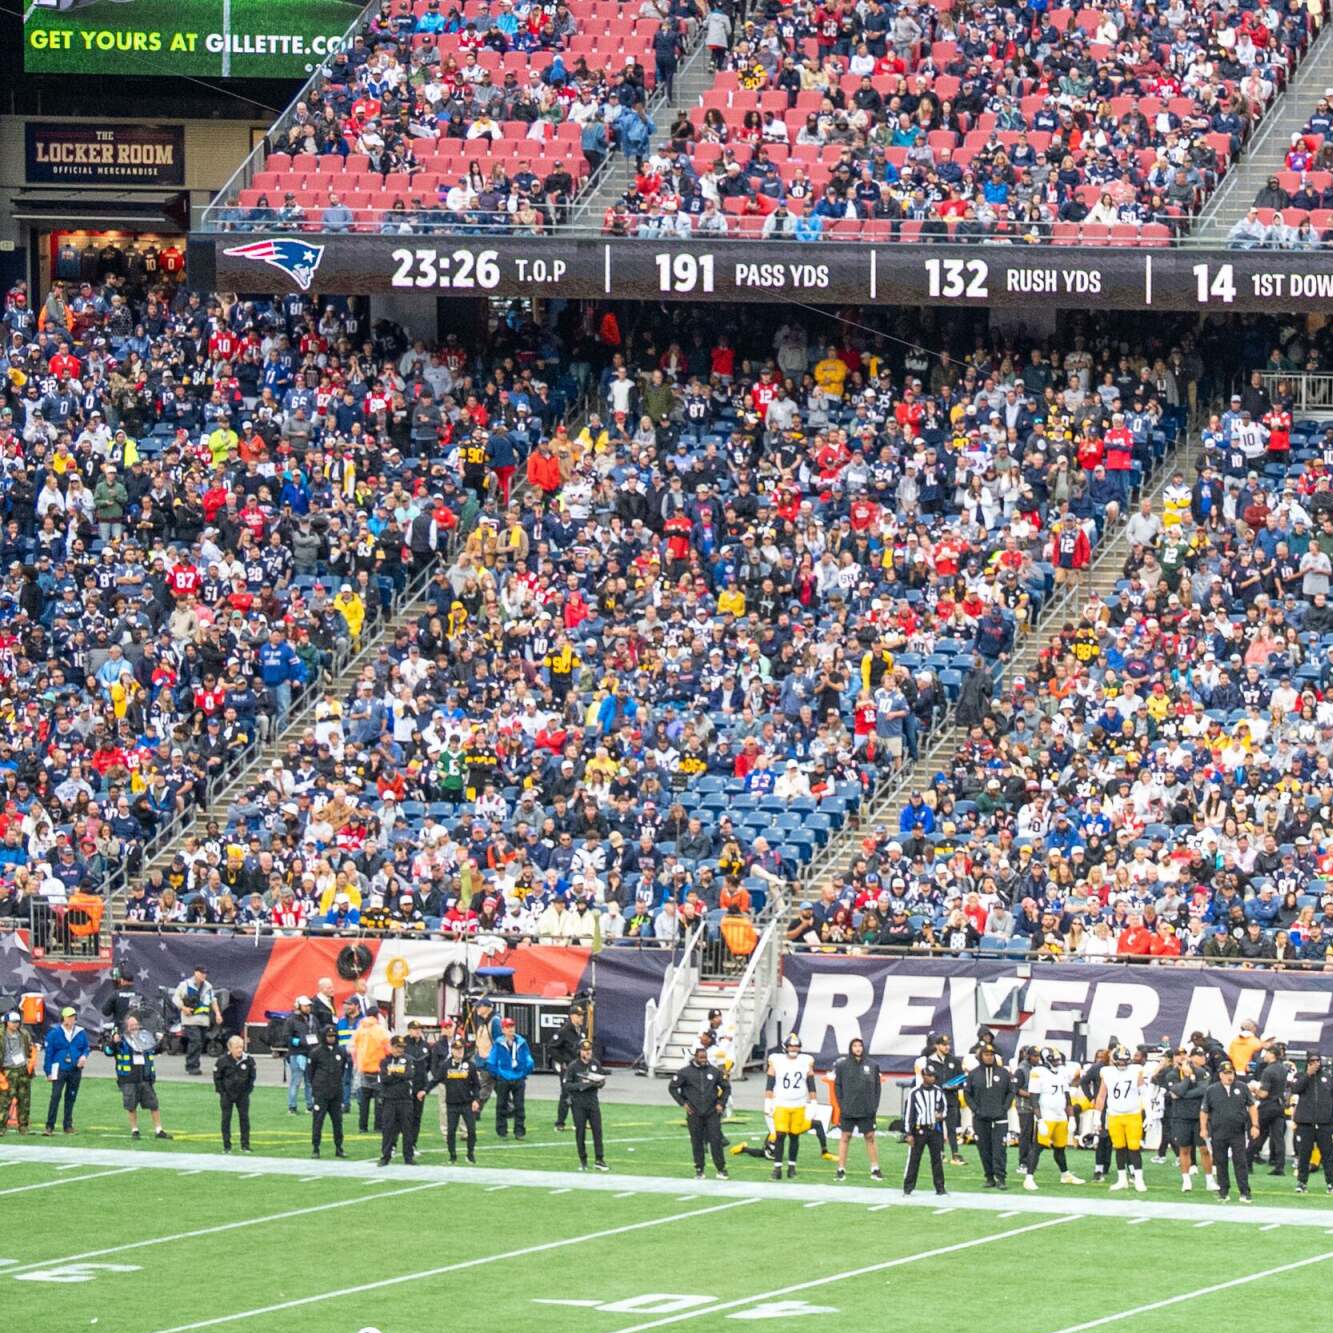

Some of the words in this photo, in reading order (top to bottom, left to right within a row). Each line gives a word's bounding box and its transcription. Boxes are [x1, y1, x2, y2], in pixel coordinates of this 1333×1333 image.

[30, 29, 74, 50] GET
[81, 30, 162, 51] YOURS
[170, 33, 198, 52] AT
[95, 130, 115, 141] THE
[36, 142, 114, 164] LOCKER
[118, 143, 174, 166] ROOM
[52, 165, 93, 176] OFFICIAL
[97, 166, 159, 177] MERCHANDISE
[391, 248, 501, 290] 23:26
[514, 258, 566, 284] T.O.P
[655, 253, 714, 293] 191
[735, 263, 785, 288] PASS
[789, 264, 830, 289] YDS
[925, 259, 989, 298] 132
[1006, 268, 1057, 293] RUSH
[1062, 269, 1102, 295] YDS
[1193, 264, 1236, 303] 14
[1251, 273, 1285, 297] 1ST
[689, 403, 705, 419] 87
[174, 572, 196, 590] 87
[783, 1072, 802, 1089] 62
[1113, 1079, 1132, 1099] 67
